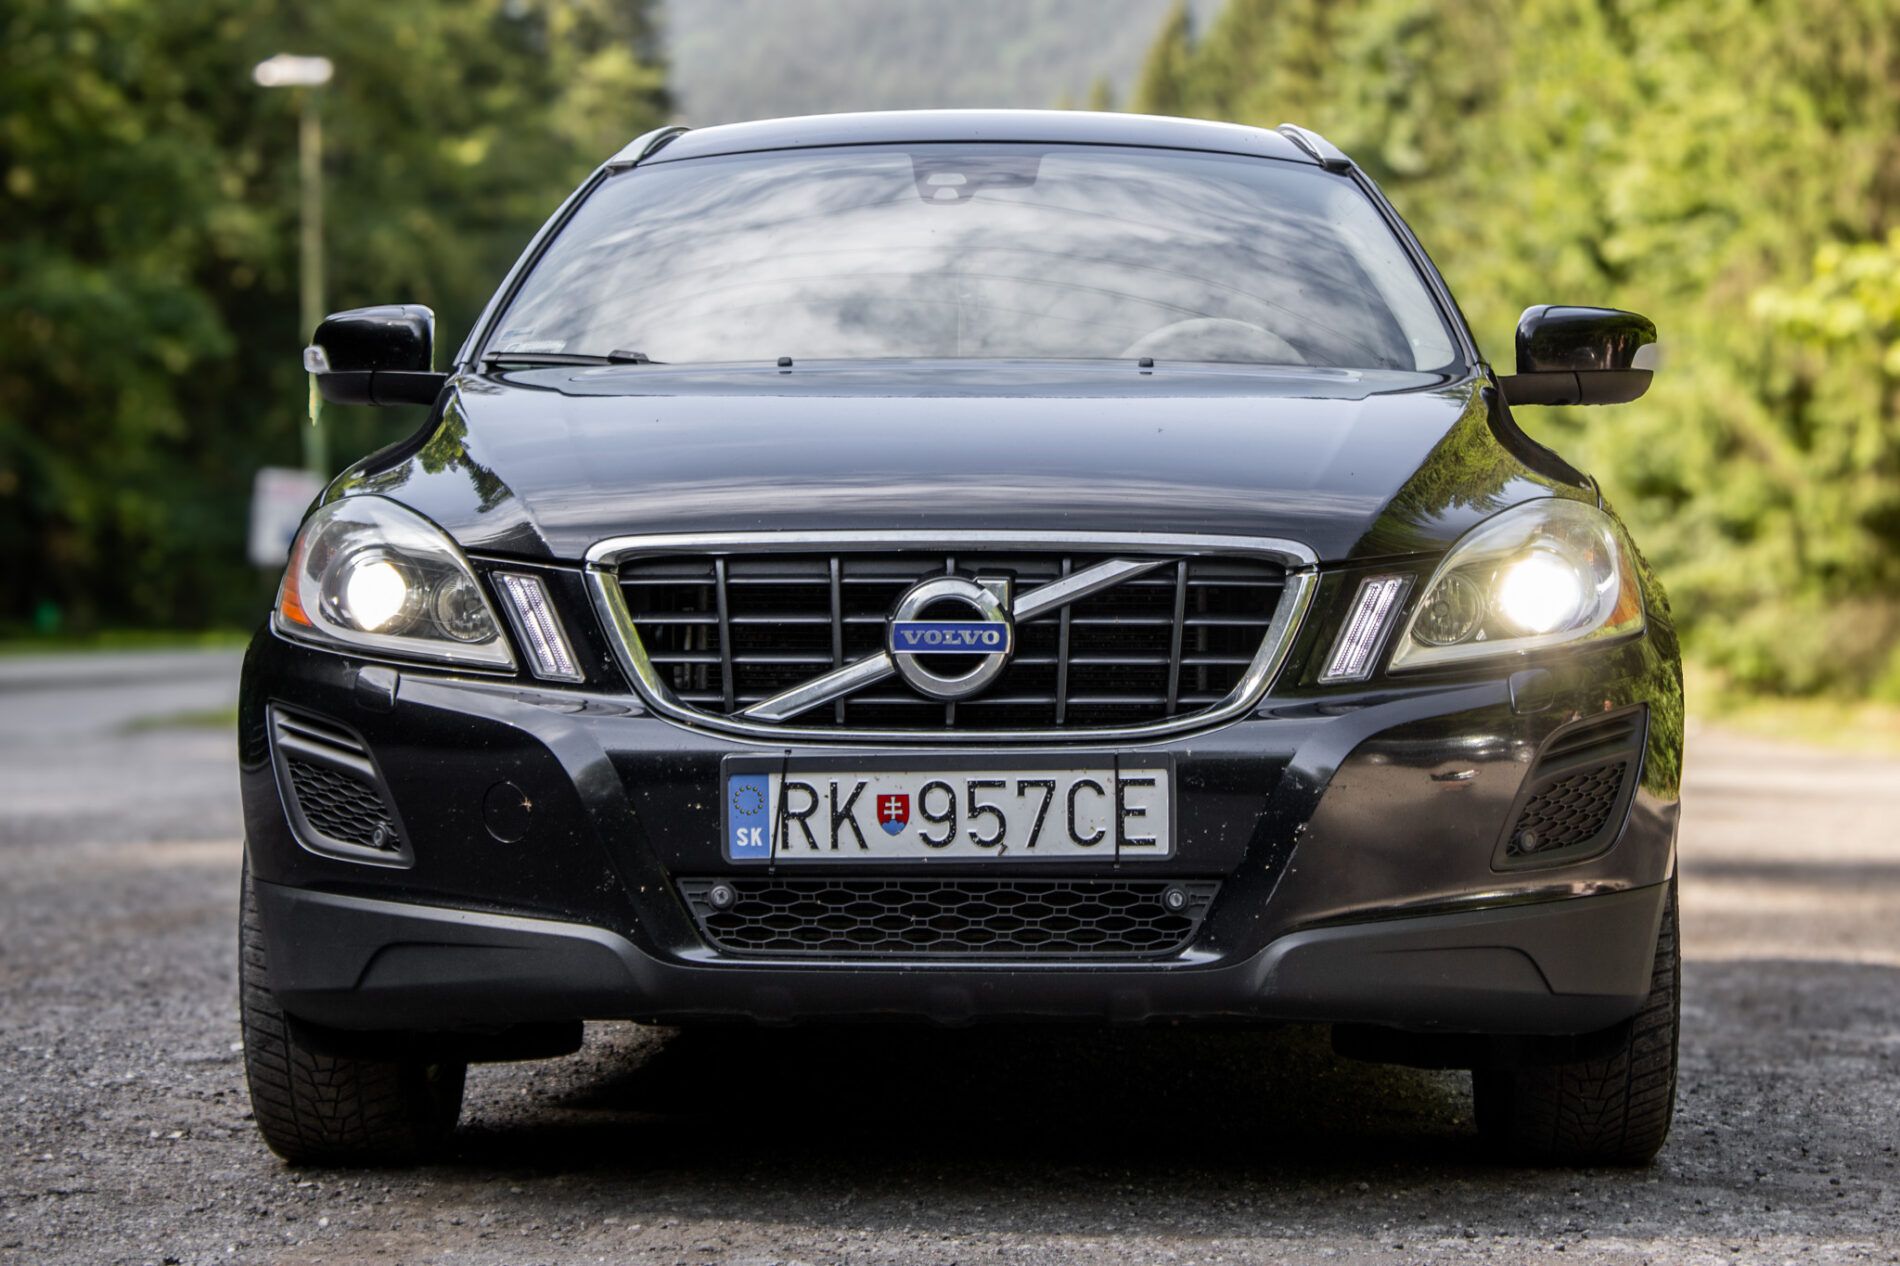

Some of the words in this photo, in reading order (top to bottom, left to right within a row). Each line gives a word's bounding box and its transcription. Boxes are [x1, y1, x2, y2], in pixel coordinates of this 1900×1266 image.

[900, 629, 1001, 646] VOLVO
[780, 780, 870, 851] RK
[917, 778, 1157, 850] 957CE
[735, 826, 763, 848] SK
